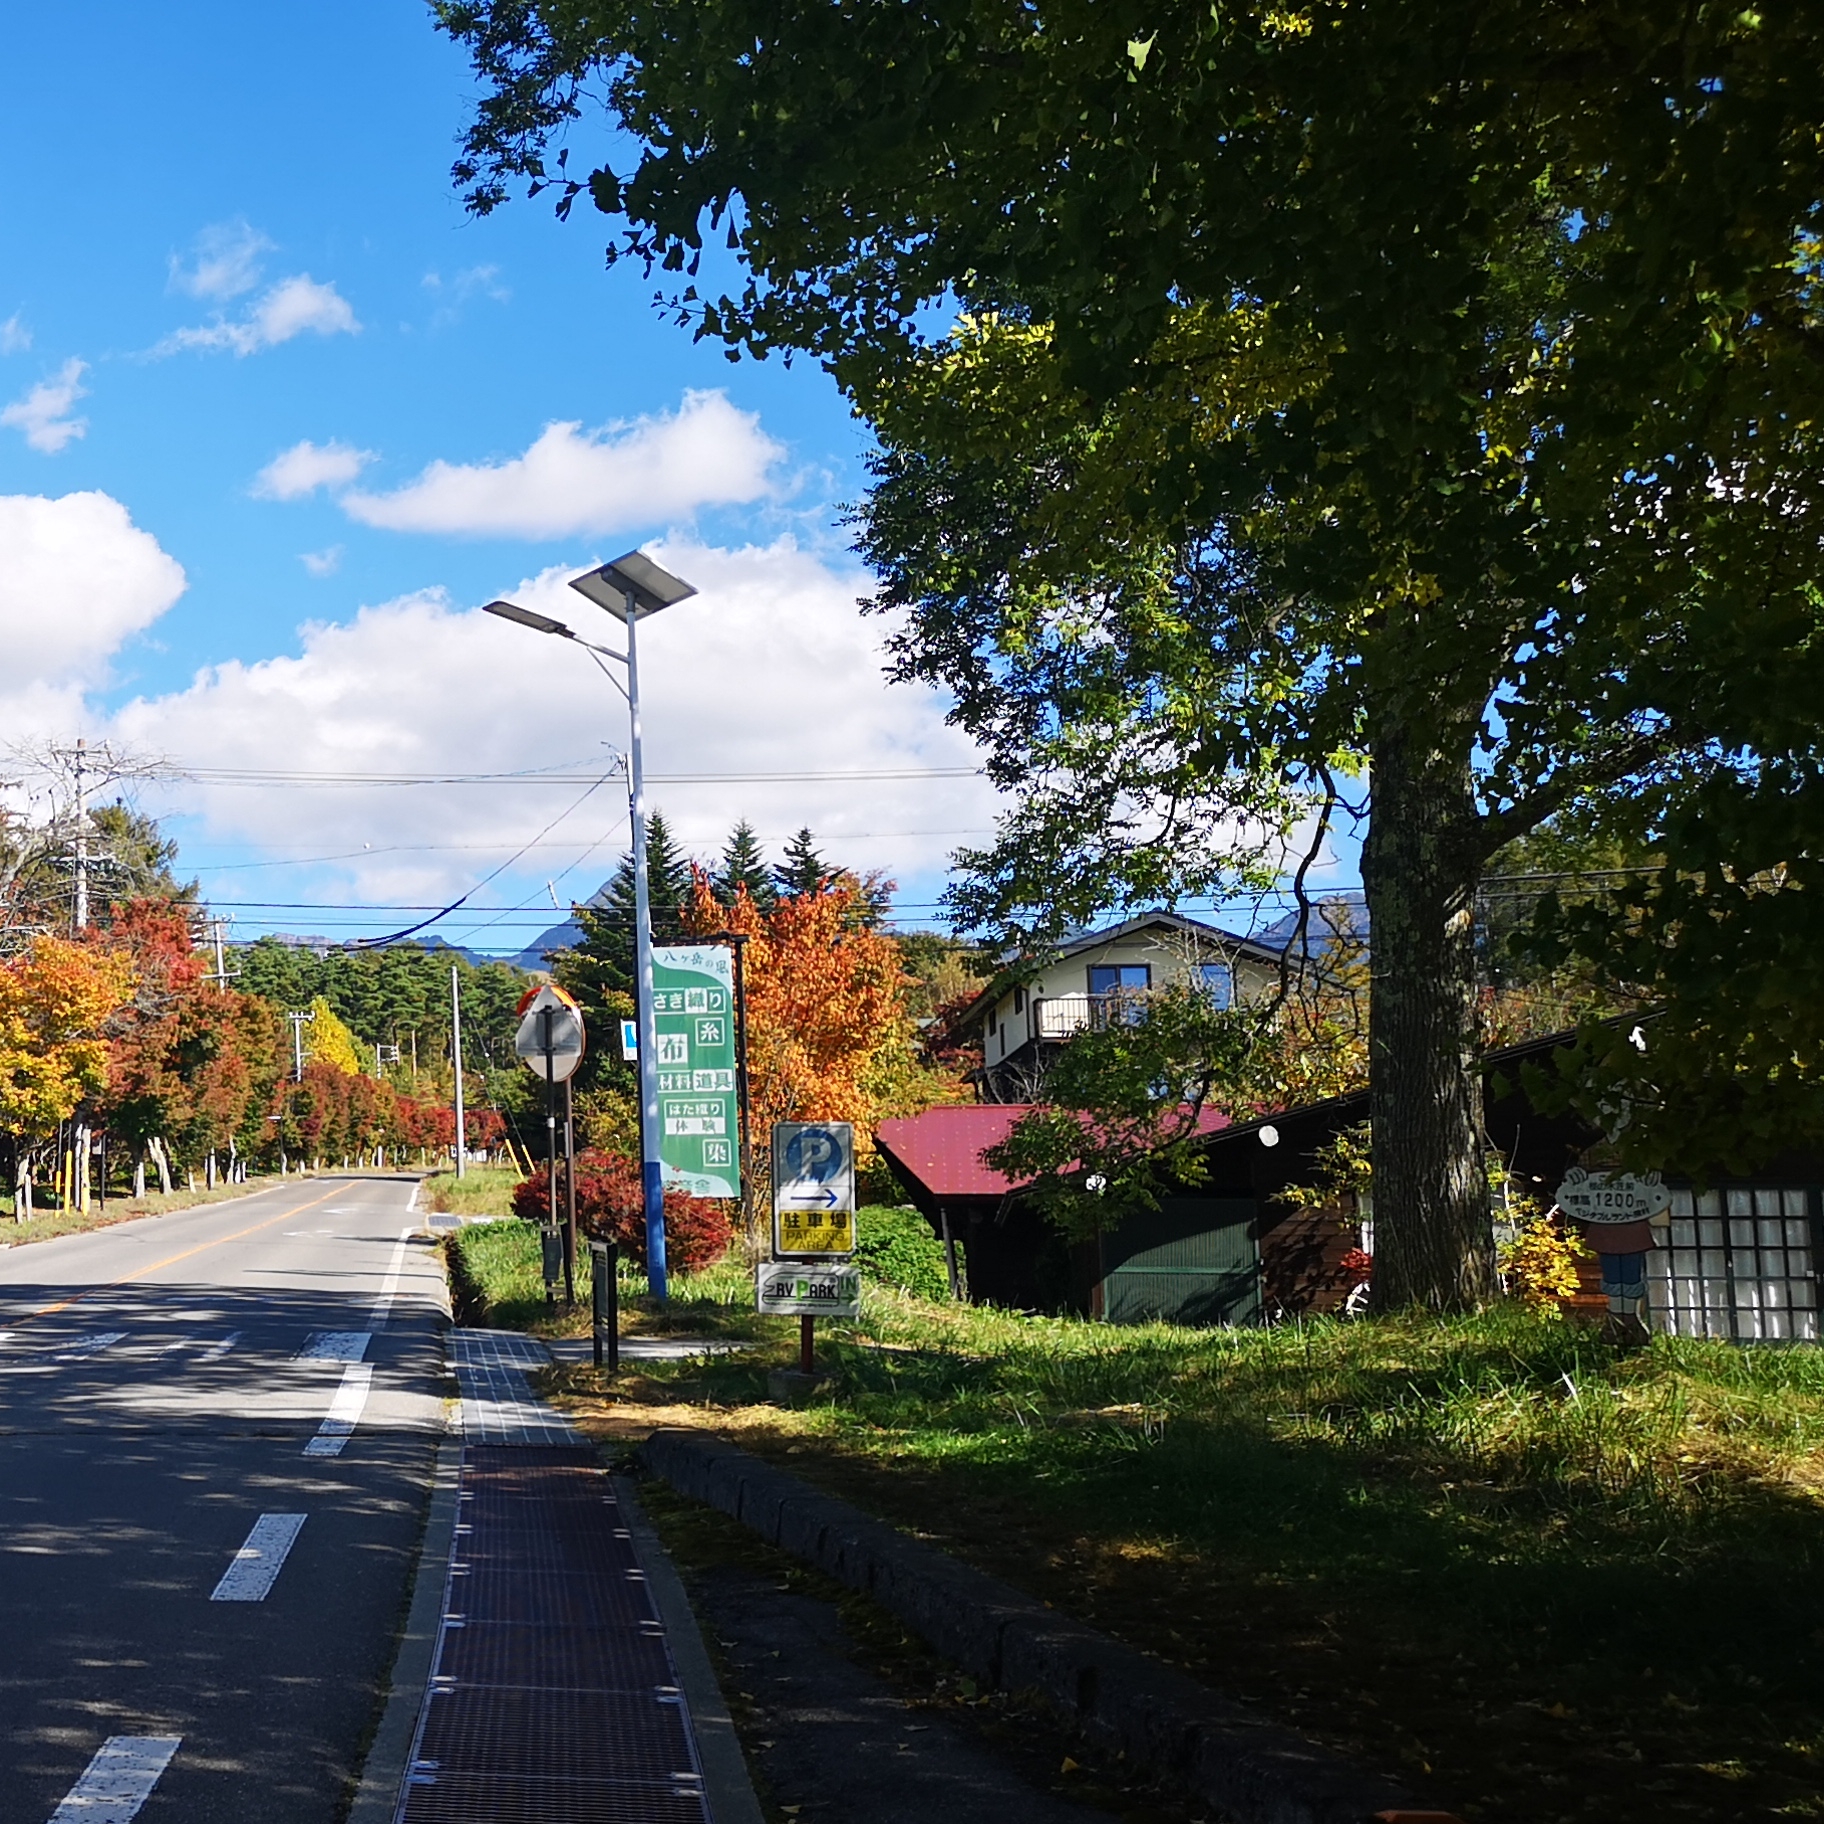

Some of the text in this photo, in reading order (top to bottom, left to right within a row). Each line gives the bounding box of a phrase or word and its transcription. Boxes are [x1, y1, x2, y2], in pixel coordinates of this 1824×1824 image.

[700, 1022, 720, 1042] 糸
[661, 1036, 685, 1061] 布
[707, 1143, 727, 1162] 染
[801, 1138, 831, 1176] P
[784, 1212, 847, 1229] 駐車場
[786, 1231, 845, 1241] PARKING
[797, 1240, 834, 1250] AREA
[776, 1280, 836, 1301] RV PARK
[840, 1276, 857, 1290] IN
